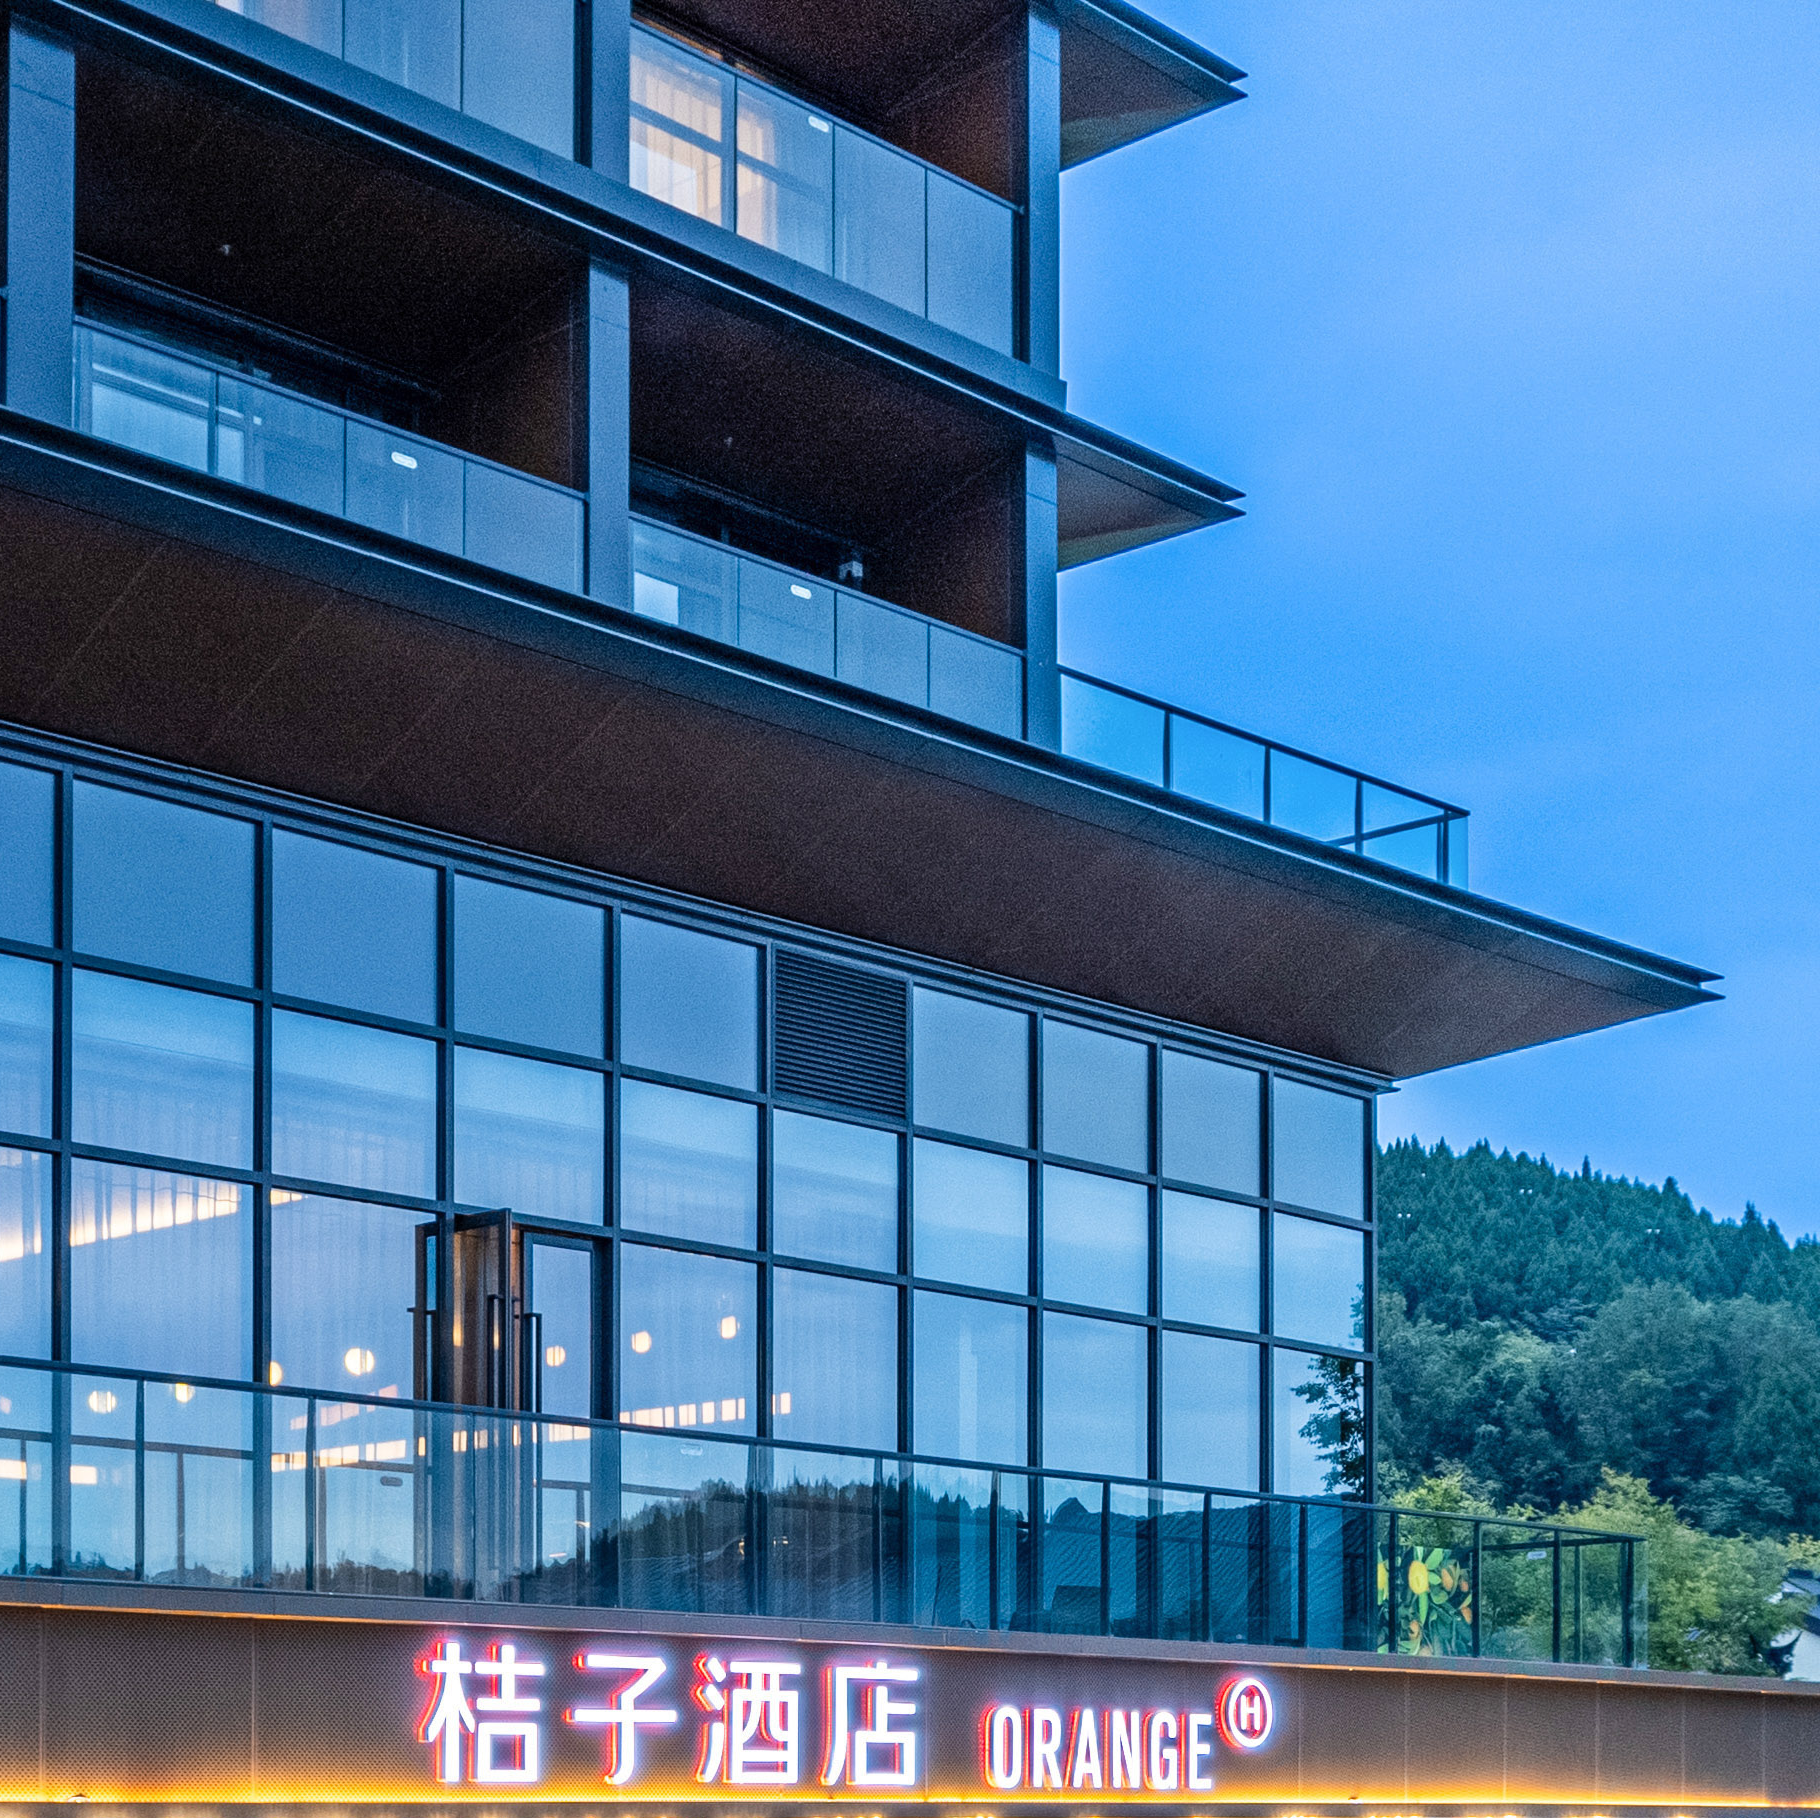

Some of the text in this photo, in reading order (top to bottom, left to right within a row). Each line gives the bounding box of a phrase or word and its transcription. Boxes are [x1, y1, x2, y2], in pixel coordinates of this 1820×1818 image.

[421, 1641, 920, 1787] 桔子酒店
[990, 1705, 1214, 1791] ORANGE
